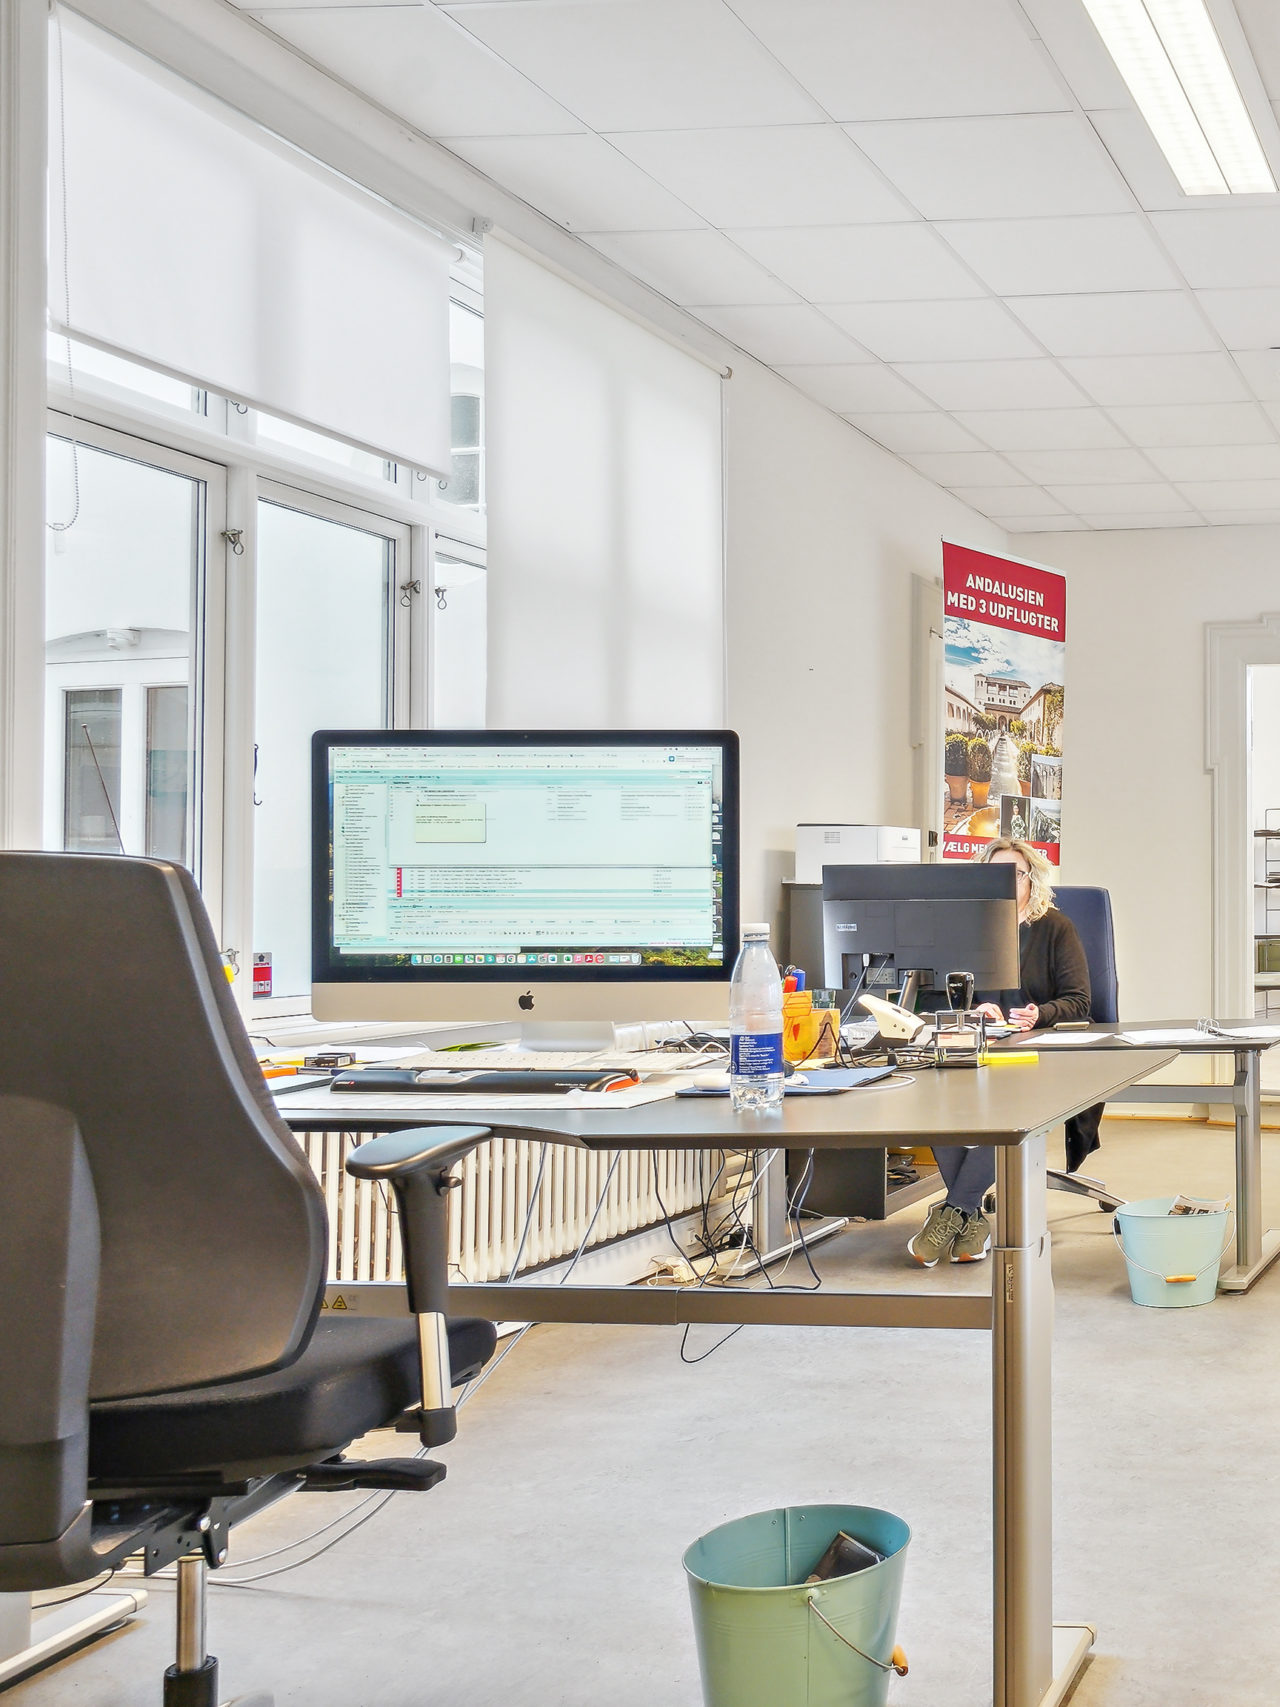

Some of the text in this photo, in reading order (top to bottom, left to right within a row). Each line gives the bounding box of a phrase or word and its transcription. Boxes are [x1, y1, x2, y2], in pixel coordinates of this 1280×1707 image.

[966, 573, 1044, 607] ANDALUSIEN
[947, 591, 1059, 632] MED 3 UDFLUGTER
